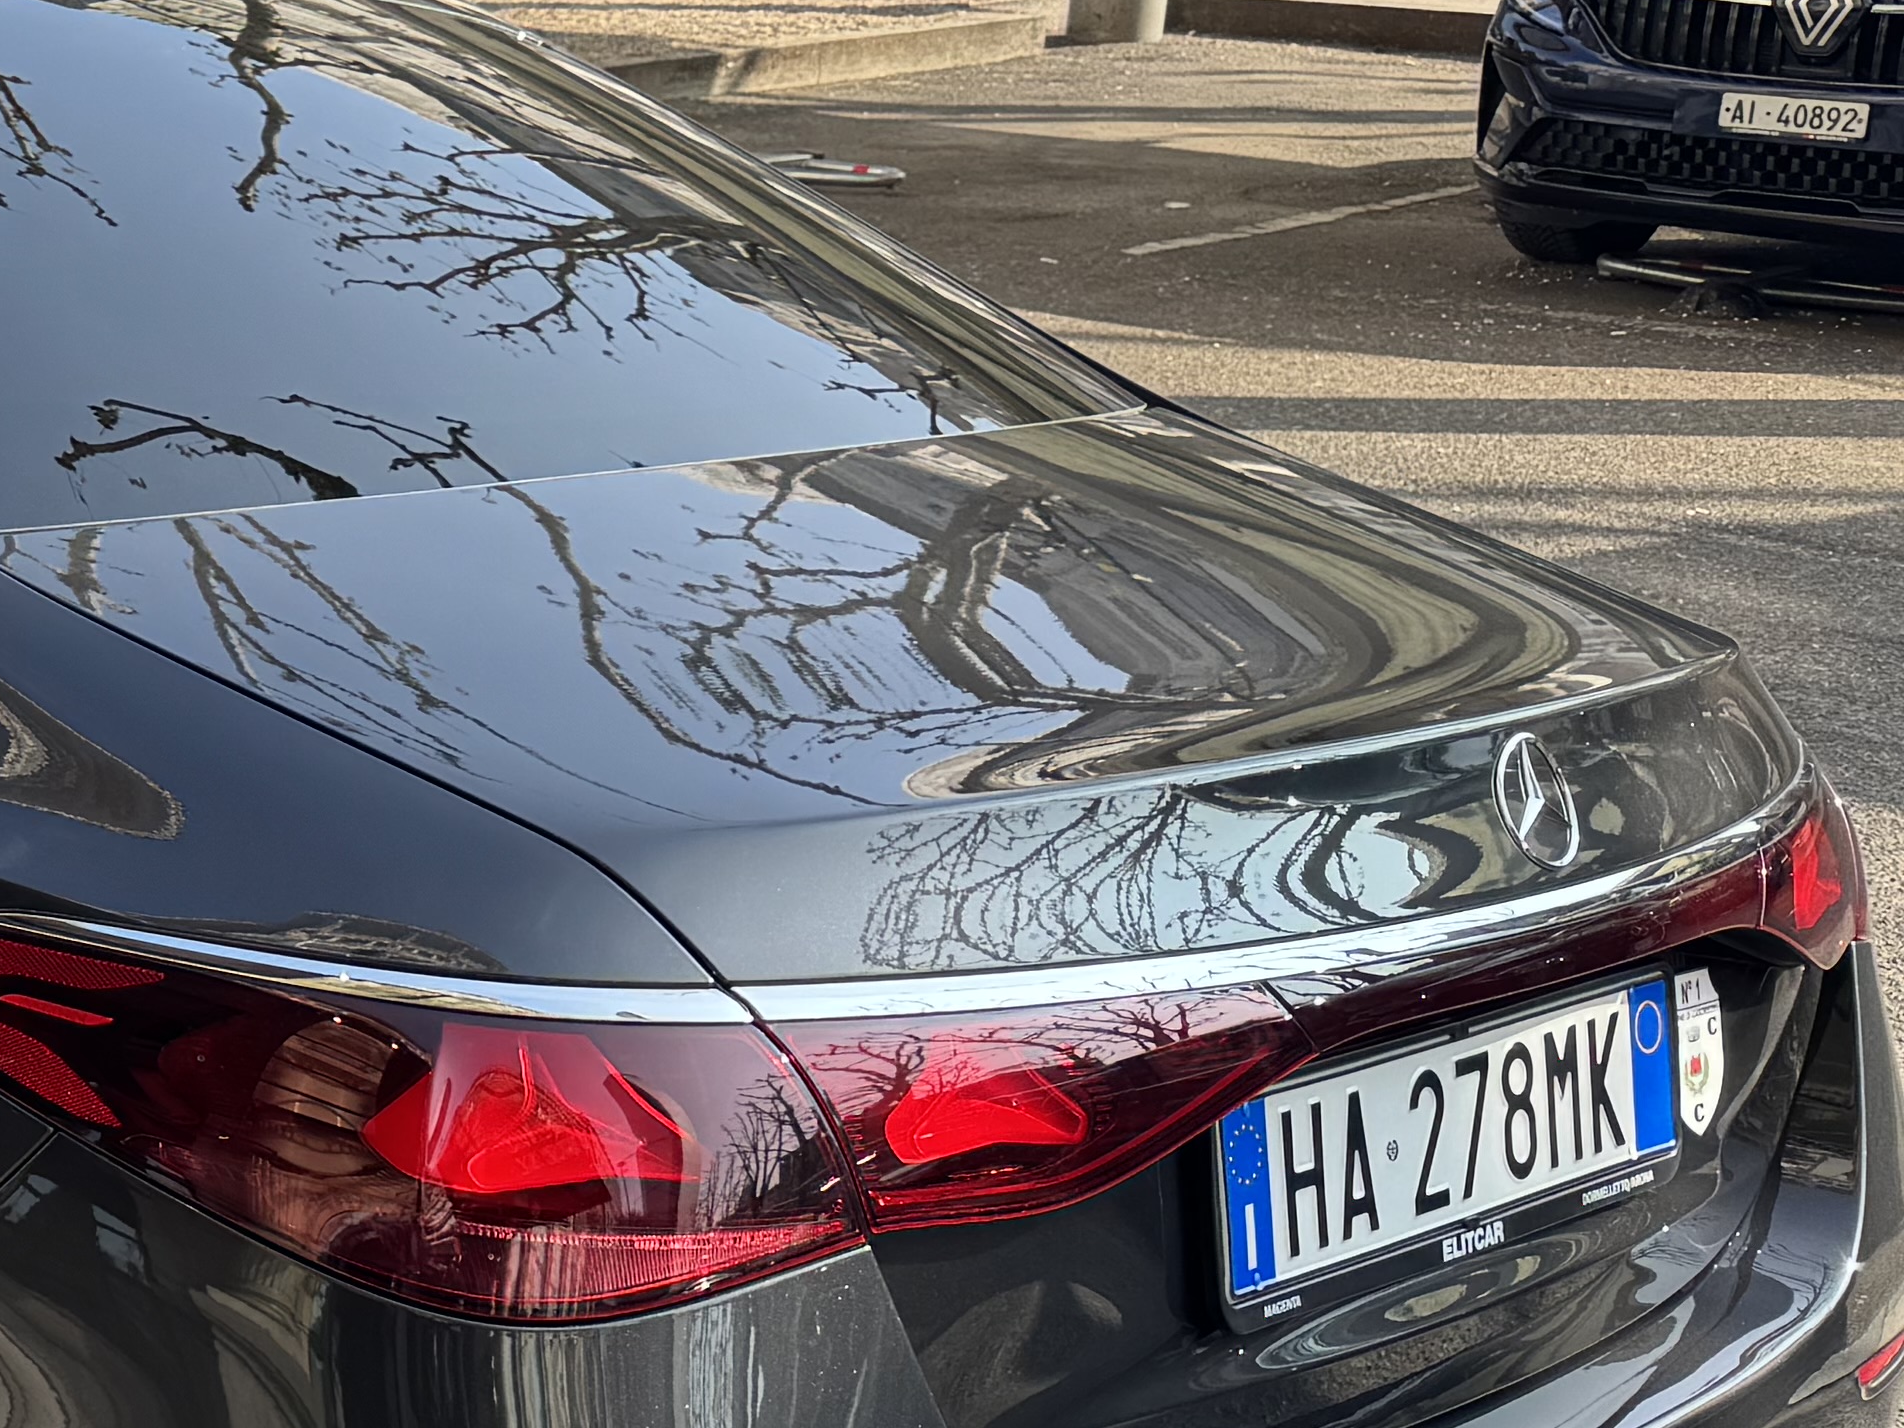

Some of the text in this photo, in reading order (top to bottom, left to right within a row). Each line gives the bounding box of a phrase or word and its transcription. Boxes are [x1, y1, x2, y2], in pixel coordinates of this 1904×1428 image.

[1777, 103, 1859, 133] 40892
[1707, 1017, 1718, 1035] C
[1694, 1103, 1705, 1122] C
[1280, 1090, 1380, 1258] HA
[1409, 1010, 1626, 1216] 278MK
[1442, 1220, 1505, 1263] ELITCAR
